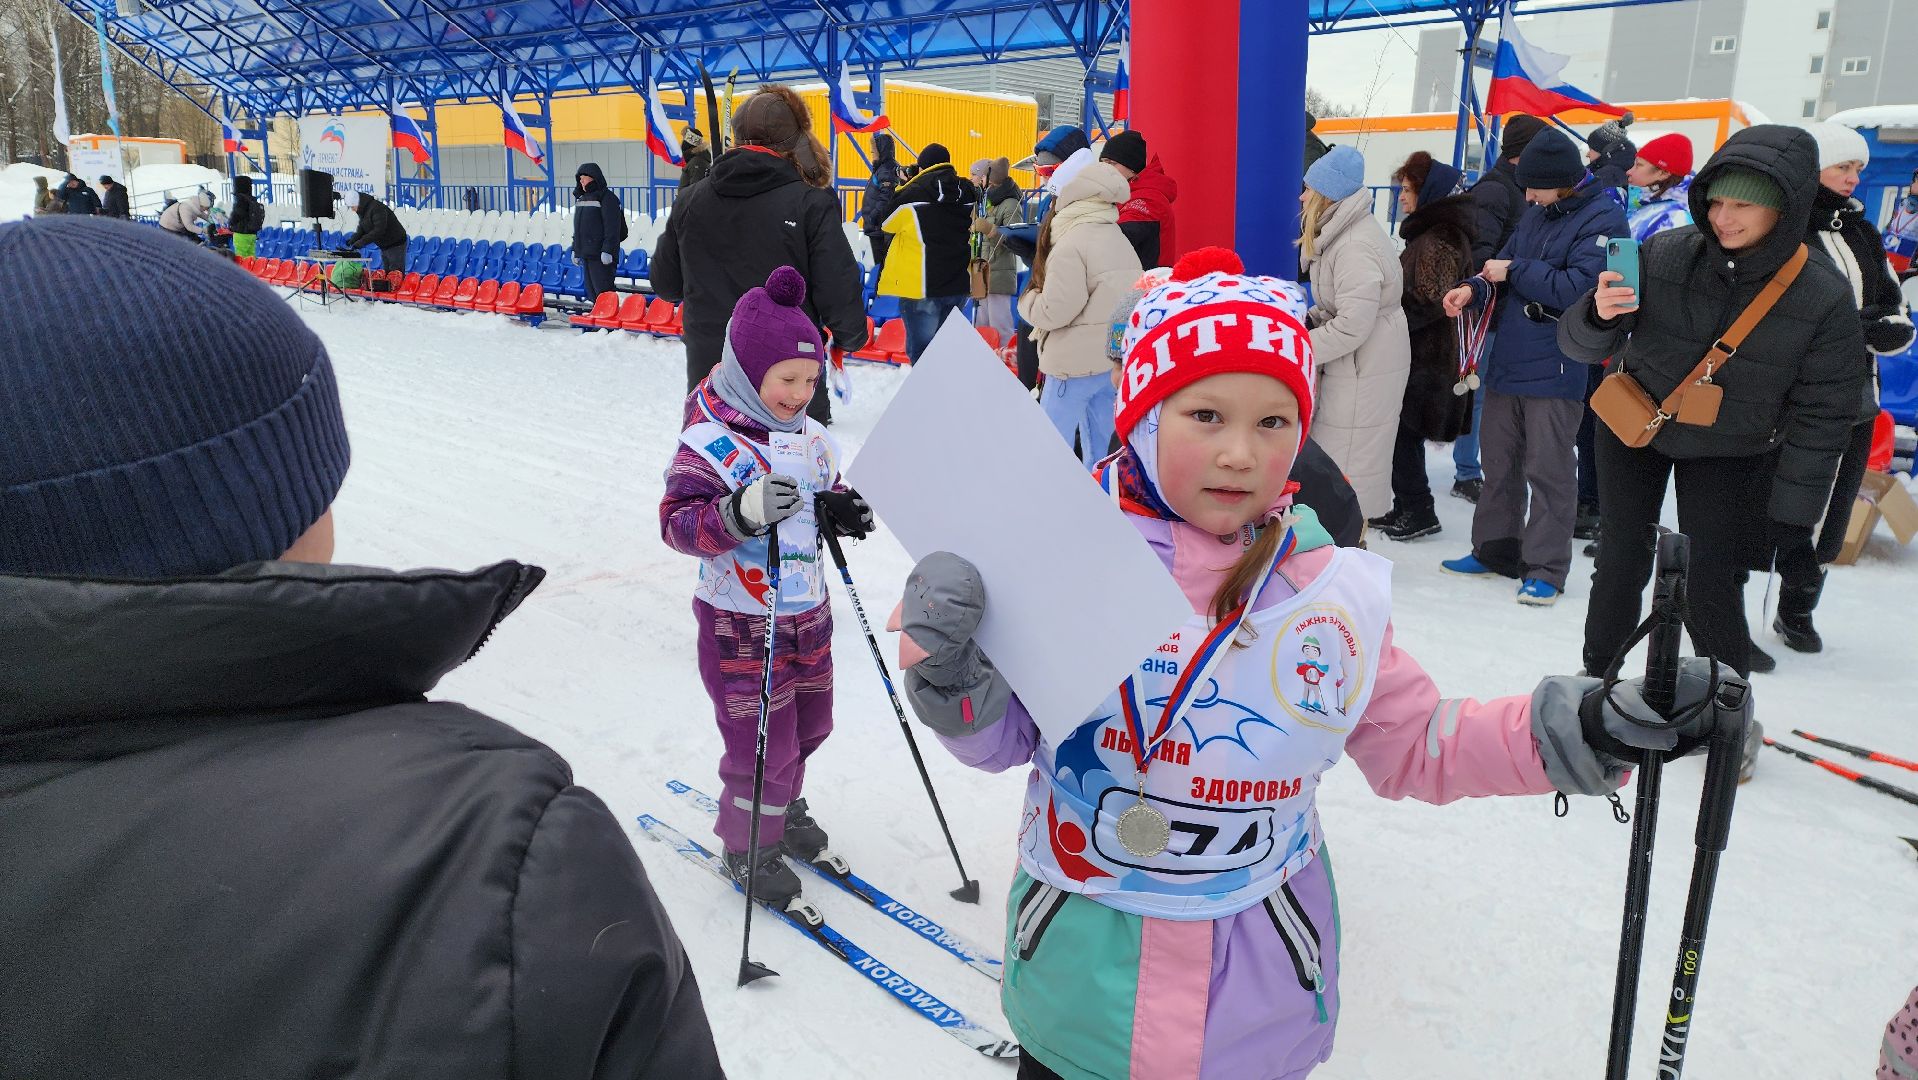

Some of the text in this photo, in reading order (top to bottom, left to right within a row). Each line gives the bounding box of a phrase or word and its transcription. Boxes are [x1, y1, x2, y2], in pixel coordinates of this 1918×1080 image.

[1295, 616, 1327, 635] ЛЫЖНЯ
[1191, 776, 1302, 804] ЗДОРОВЬЯ
[854, 957, 963, 1023] NORDWAY
